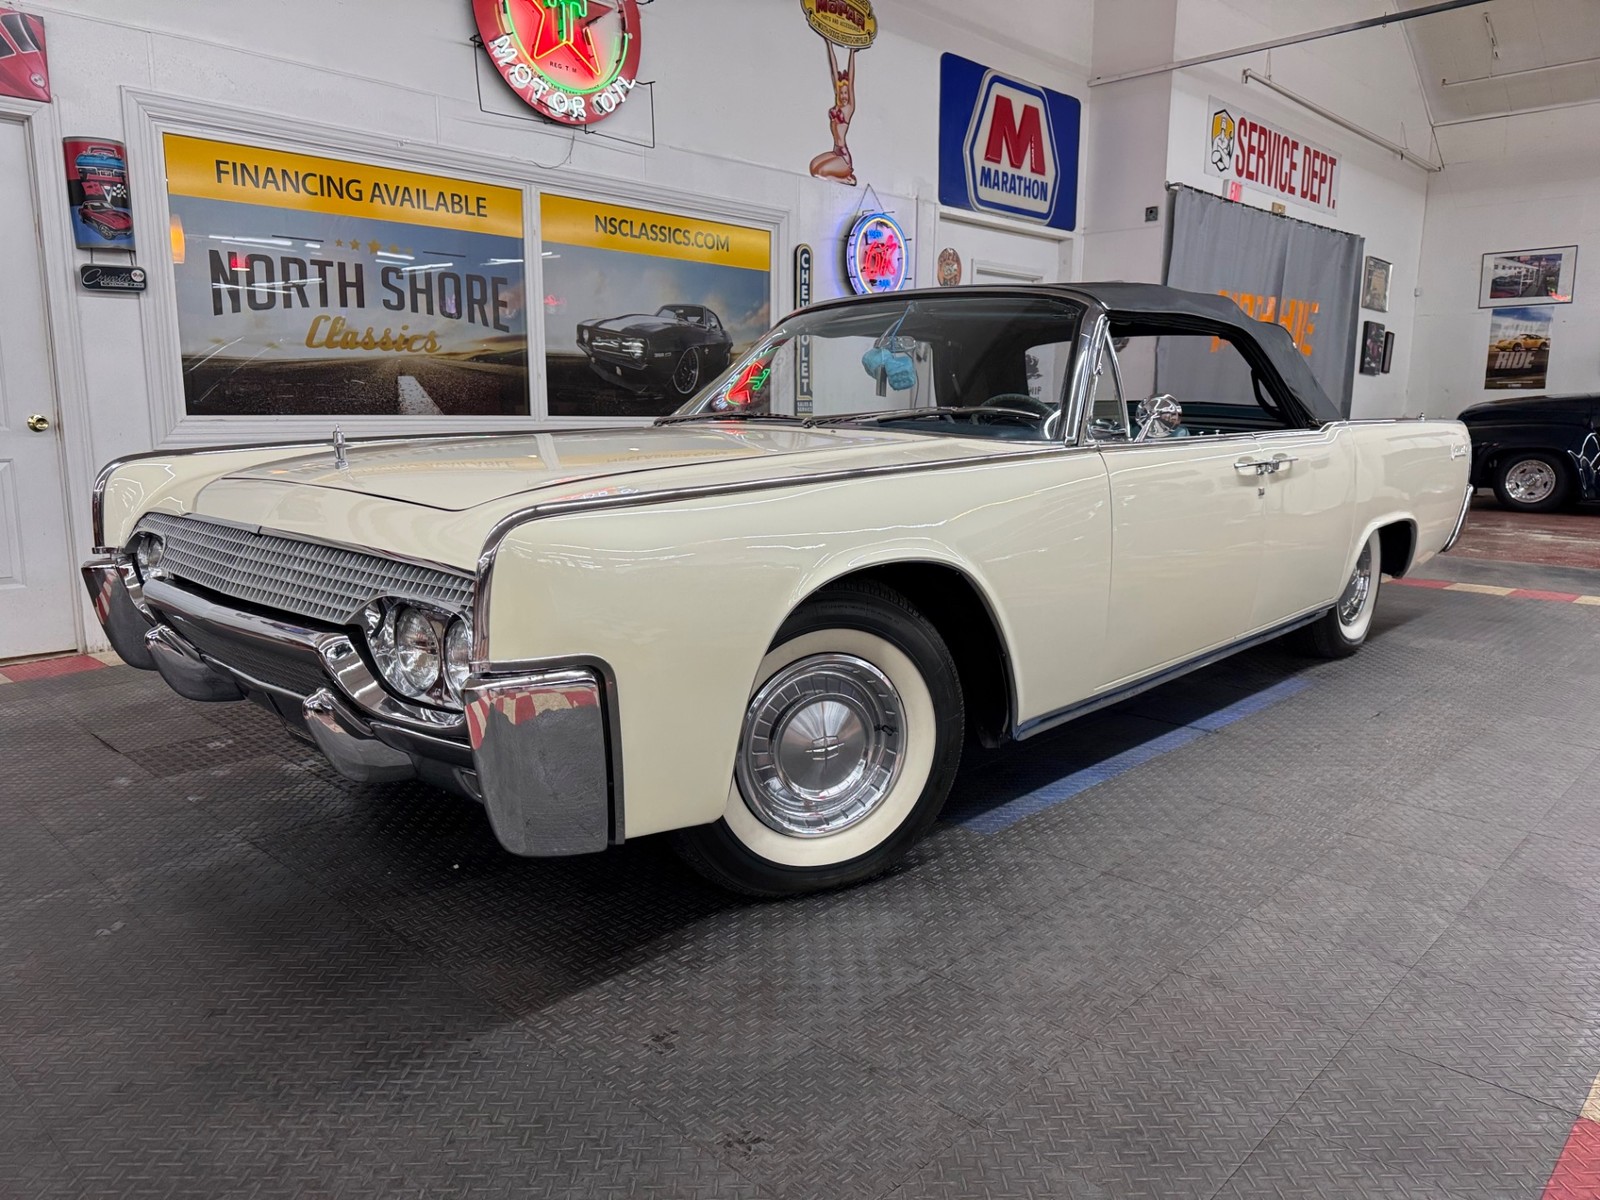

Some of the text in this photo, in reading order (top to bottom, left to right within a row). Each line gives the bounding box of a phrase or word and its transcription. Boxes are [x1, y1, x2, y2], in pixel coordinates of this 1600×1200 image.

[489, 35, 636, 121] MOTOR OIL
[984, 94, 1046, 176] M
[1235, 117, 1337, 209] SERVICE DEPT.
[215, 159, 488, 218] FINANCING AVAILABLE
[979, 166, 1048, 202] MARATHON
[594, 214, 730, 252] NSCLASSICS.COM
[208, 249, 510, 333] NORTH SHORE
[305, 314, 442, 353] Classics
[1494, 351, 1535, 370] RIDE
